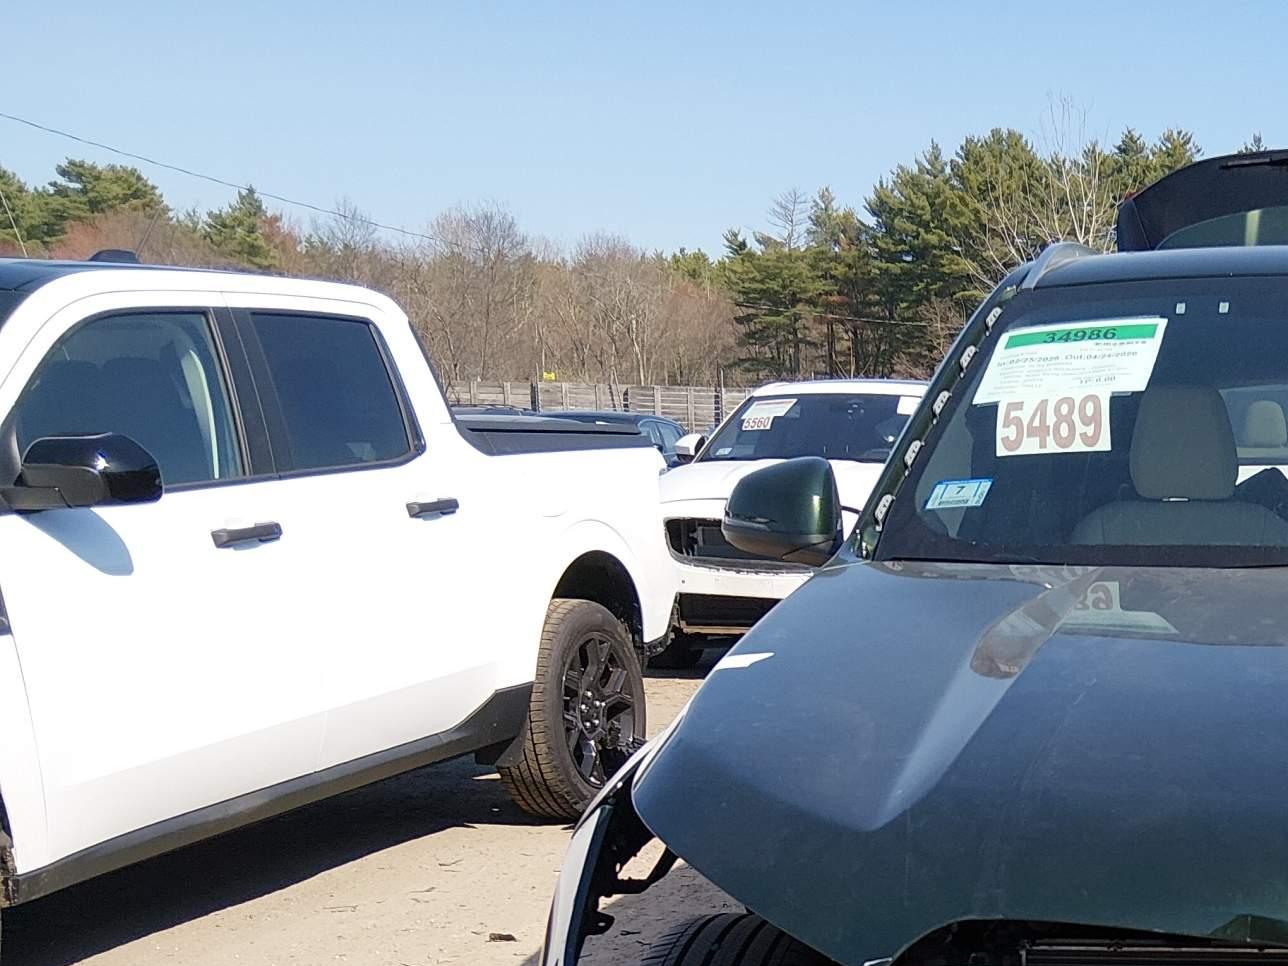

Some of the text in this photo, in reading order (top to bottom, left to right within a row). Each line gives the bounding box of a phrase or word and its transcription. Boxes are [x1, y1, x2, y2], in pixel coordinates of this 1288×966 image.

[1042, 327, 1118, 344] 34986
[744, 416, 770, 429] 5560
[1000, 393, 1103, 452] 5489
